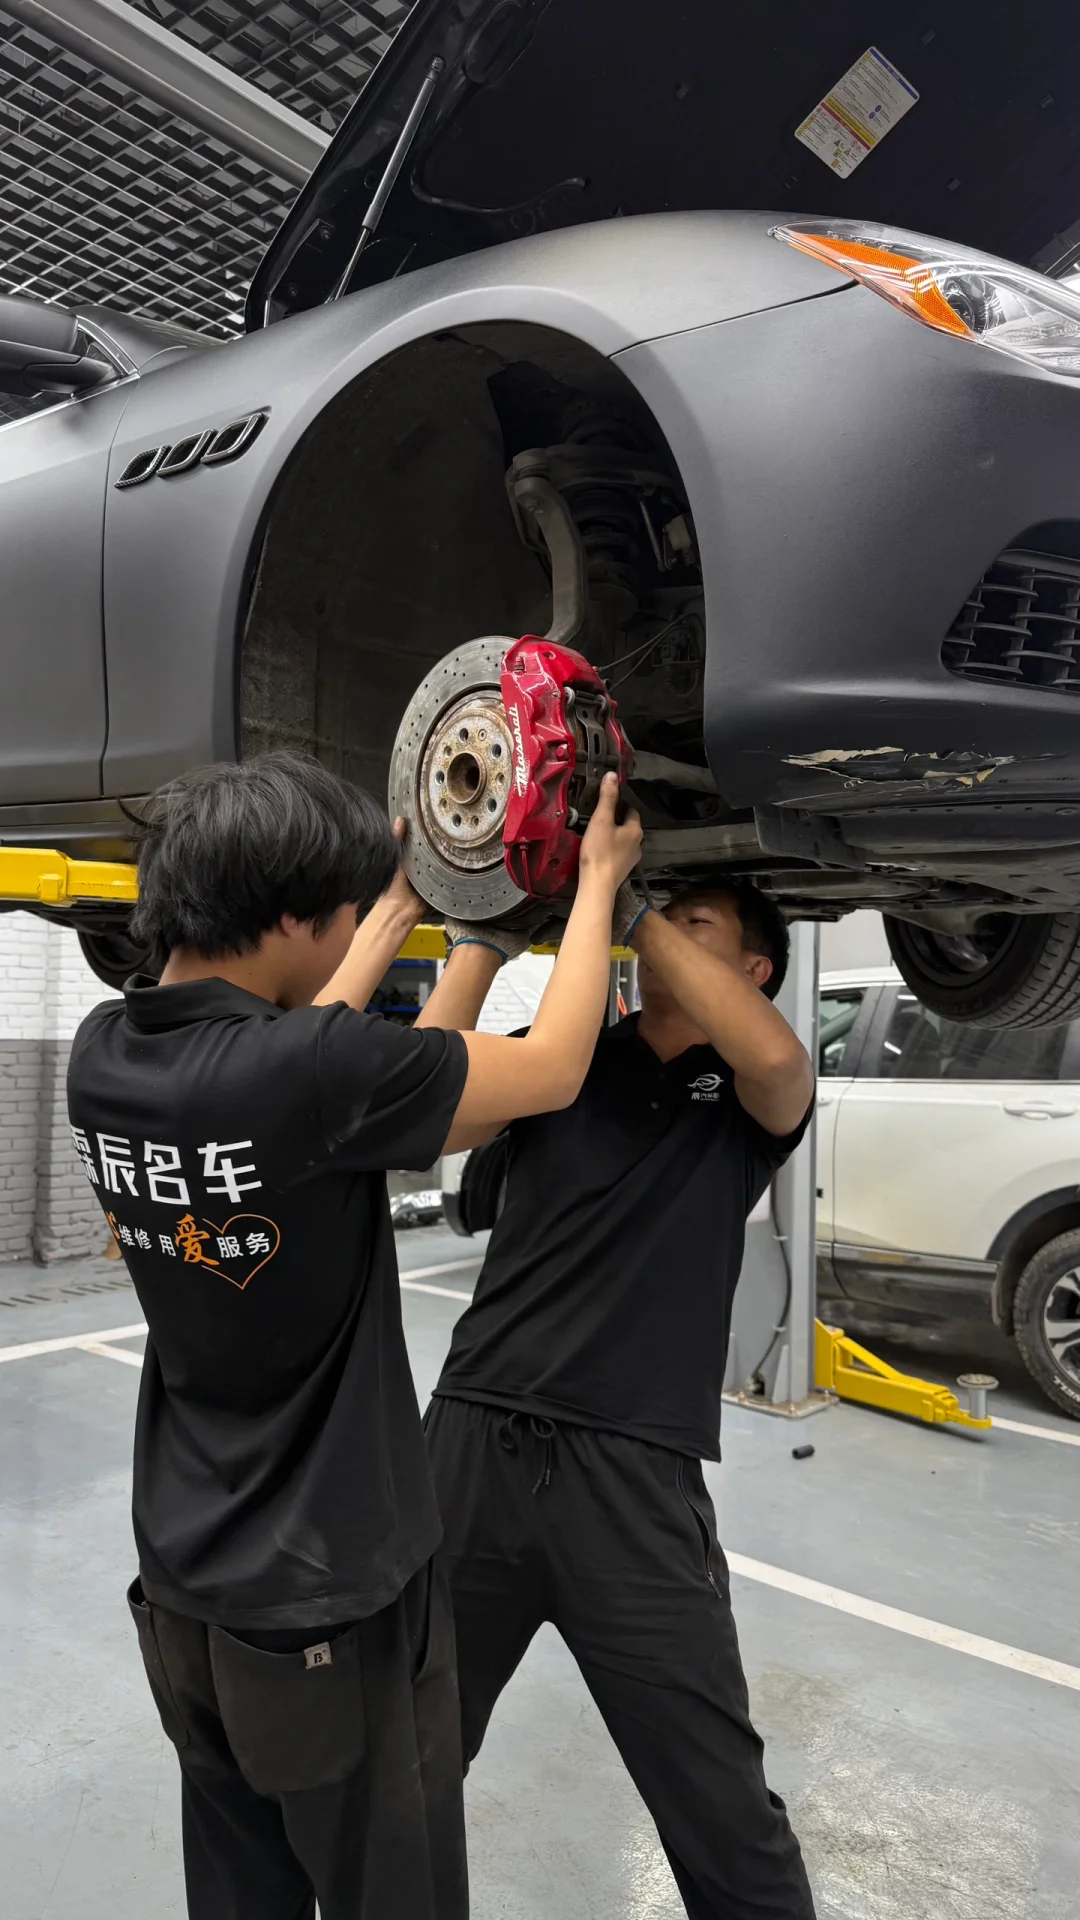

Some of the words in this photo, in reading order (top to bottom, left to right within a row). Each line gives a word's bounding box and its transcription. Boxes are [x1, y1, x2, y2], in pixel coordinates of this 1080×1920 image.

[508, 703, 528, 797] Maserati
[158, 1213, 270, 1266] 用爱服务
